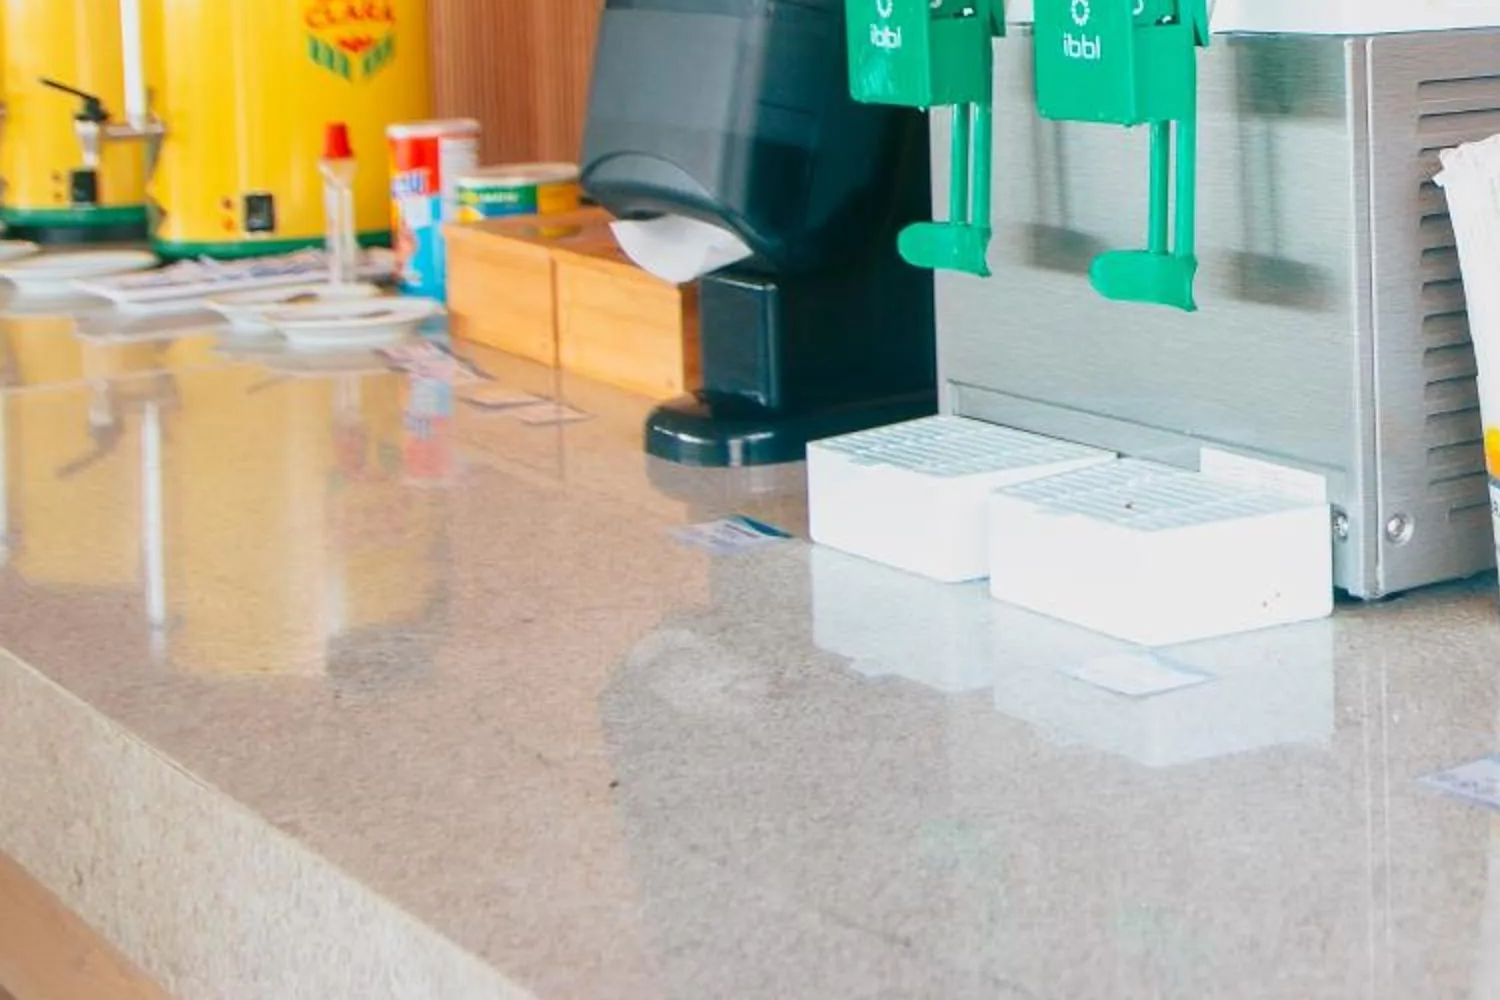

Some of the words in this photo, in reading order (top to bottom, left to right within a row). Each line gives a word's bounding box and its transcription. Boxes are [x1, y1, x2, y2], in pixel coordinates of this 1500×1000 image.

[303, 2, 396, 29] CLARA
[870, 23, 902, 49] ibbl
[1063, 32, 1101, 60] ibbl
